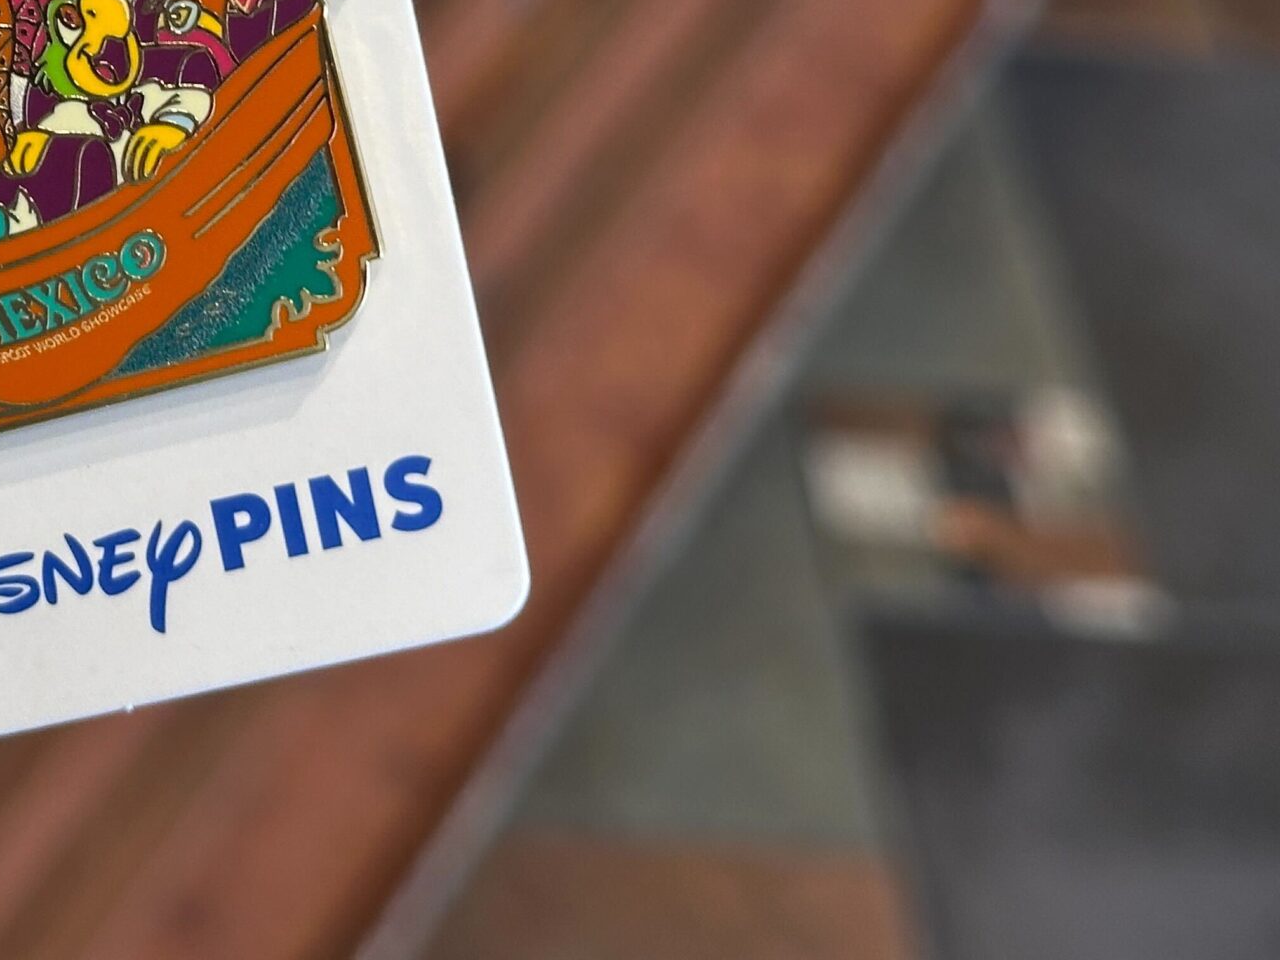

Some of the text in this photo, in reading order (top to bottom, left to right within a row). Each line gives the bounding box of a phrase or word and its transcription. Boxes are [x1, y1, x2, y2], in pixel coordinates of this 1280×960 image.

[33, 325, 81, 355] WORLD
[80, 283, 152, 335] SHOWCASE
[210, 455, 443, 572] PINS
